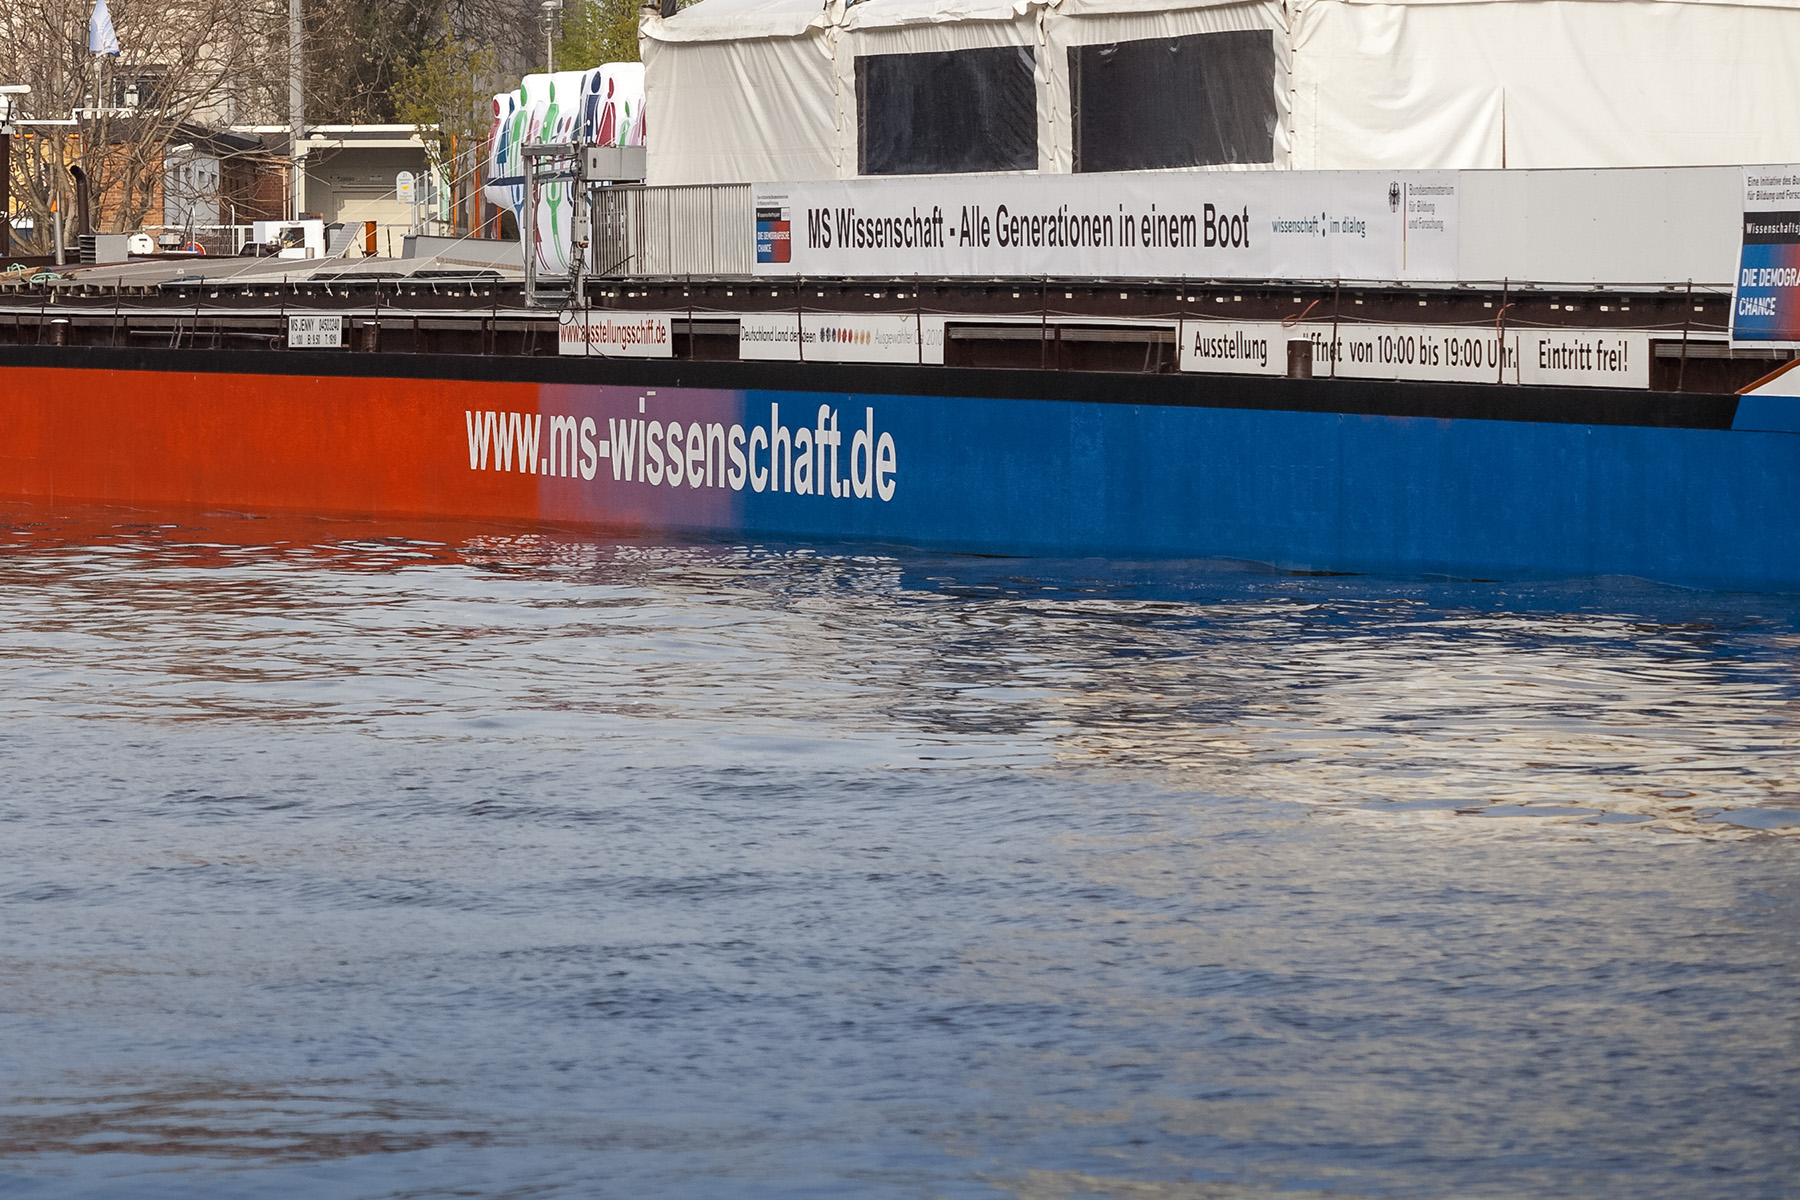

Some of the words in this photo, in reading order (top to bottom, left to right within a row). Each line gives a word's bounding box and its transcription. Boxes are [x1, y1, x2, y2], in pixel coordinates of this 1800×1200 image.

[1408, 183, 1455, 196] Bundesministerium
[1747, 176, 1759, 187] Eine
[1782, 175, 1791, 186] des
[1747, 191, 1755, 200] für
[1756, 190, 1775, 203] Bildung
[1776, 190, 1785, 200] und
[1408, 201, 1416, 212] für
[1416, 200, 1436, 215] Bildung
[807, 207, 832, 249] MS
[835, 205, 944, 249] Wissenschaft
[949, 227, 956, 237] -
[959, 205, 991, 248] Alle
[996, 203, 1114, 248] Generationen
[1119, 203, 1136, 247] in
[1141, 203, 1197, 248] einem
[1203, 202, 1250, 248] Boot
[1271, 216, 1319, 238] wissenschaft
[1329, 216, 1340, 234] im
[1341, 216, 1366, 239] dialog
[1408, 217, 1418, 230] und
[1418, 217, 1444, 232] Forschung
[1741, 268, 1758, 287] DIE
[1738, 296, 1777, 316] CHANCE
[741, 326, 774, 342] Deutschland
[774, 326, 789, 342] Land
[874, 326, 913, 350] Ausgewählter
[926, 328, 943, 346] 2010
[1193, 330, 1268, 368] Ausstellung
[1302, 332, 1344, 363] ffnet
[1349, 340, 1373, 364] von
[1377, 335, 1415, 365] 10:00
[1419, 334, 1439, 367] bis
[1444, 337, 1483, 369] 19:00
[1539, 338, 1593, 371] Eintritt
[1596, 338, 1629, 372] frei!
[464, 396, 897, 502] www.ms-wissenschaft.de
